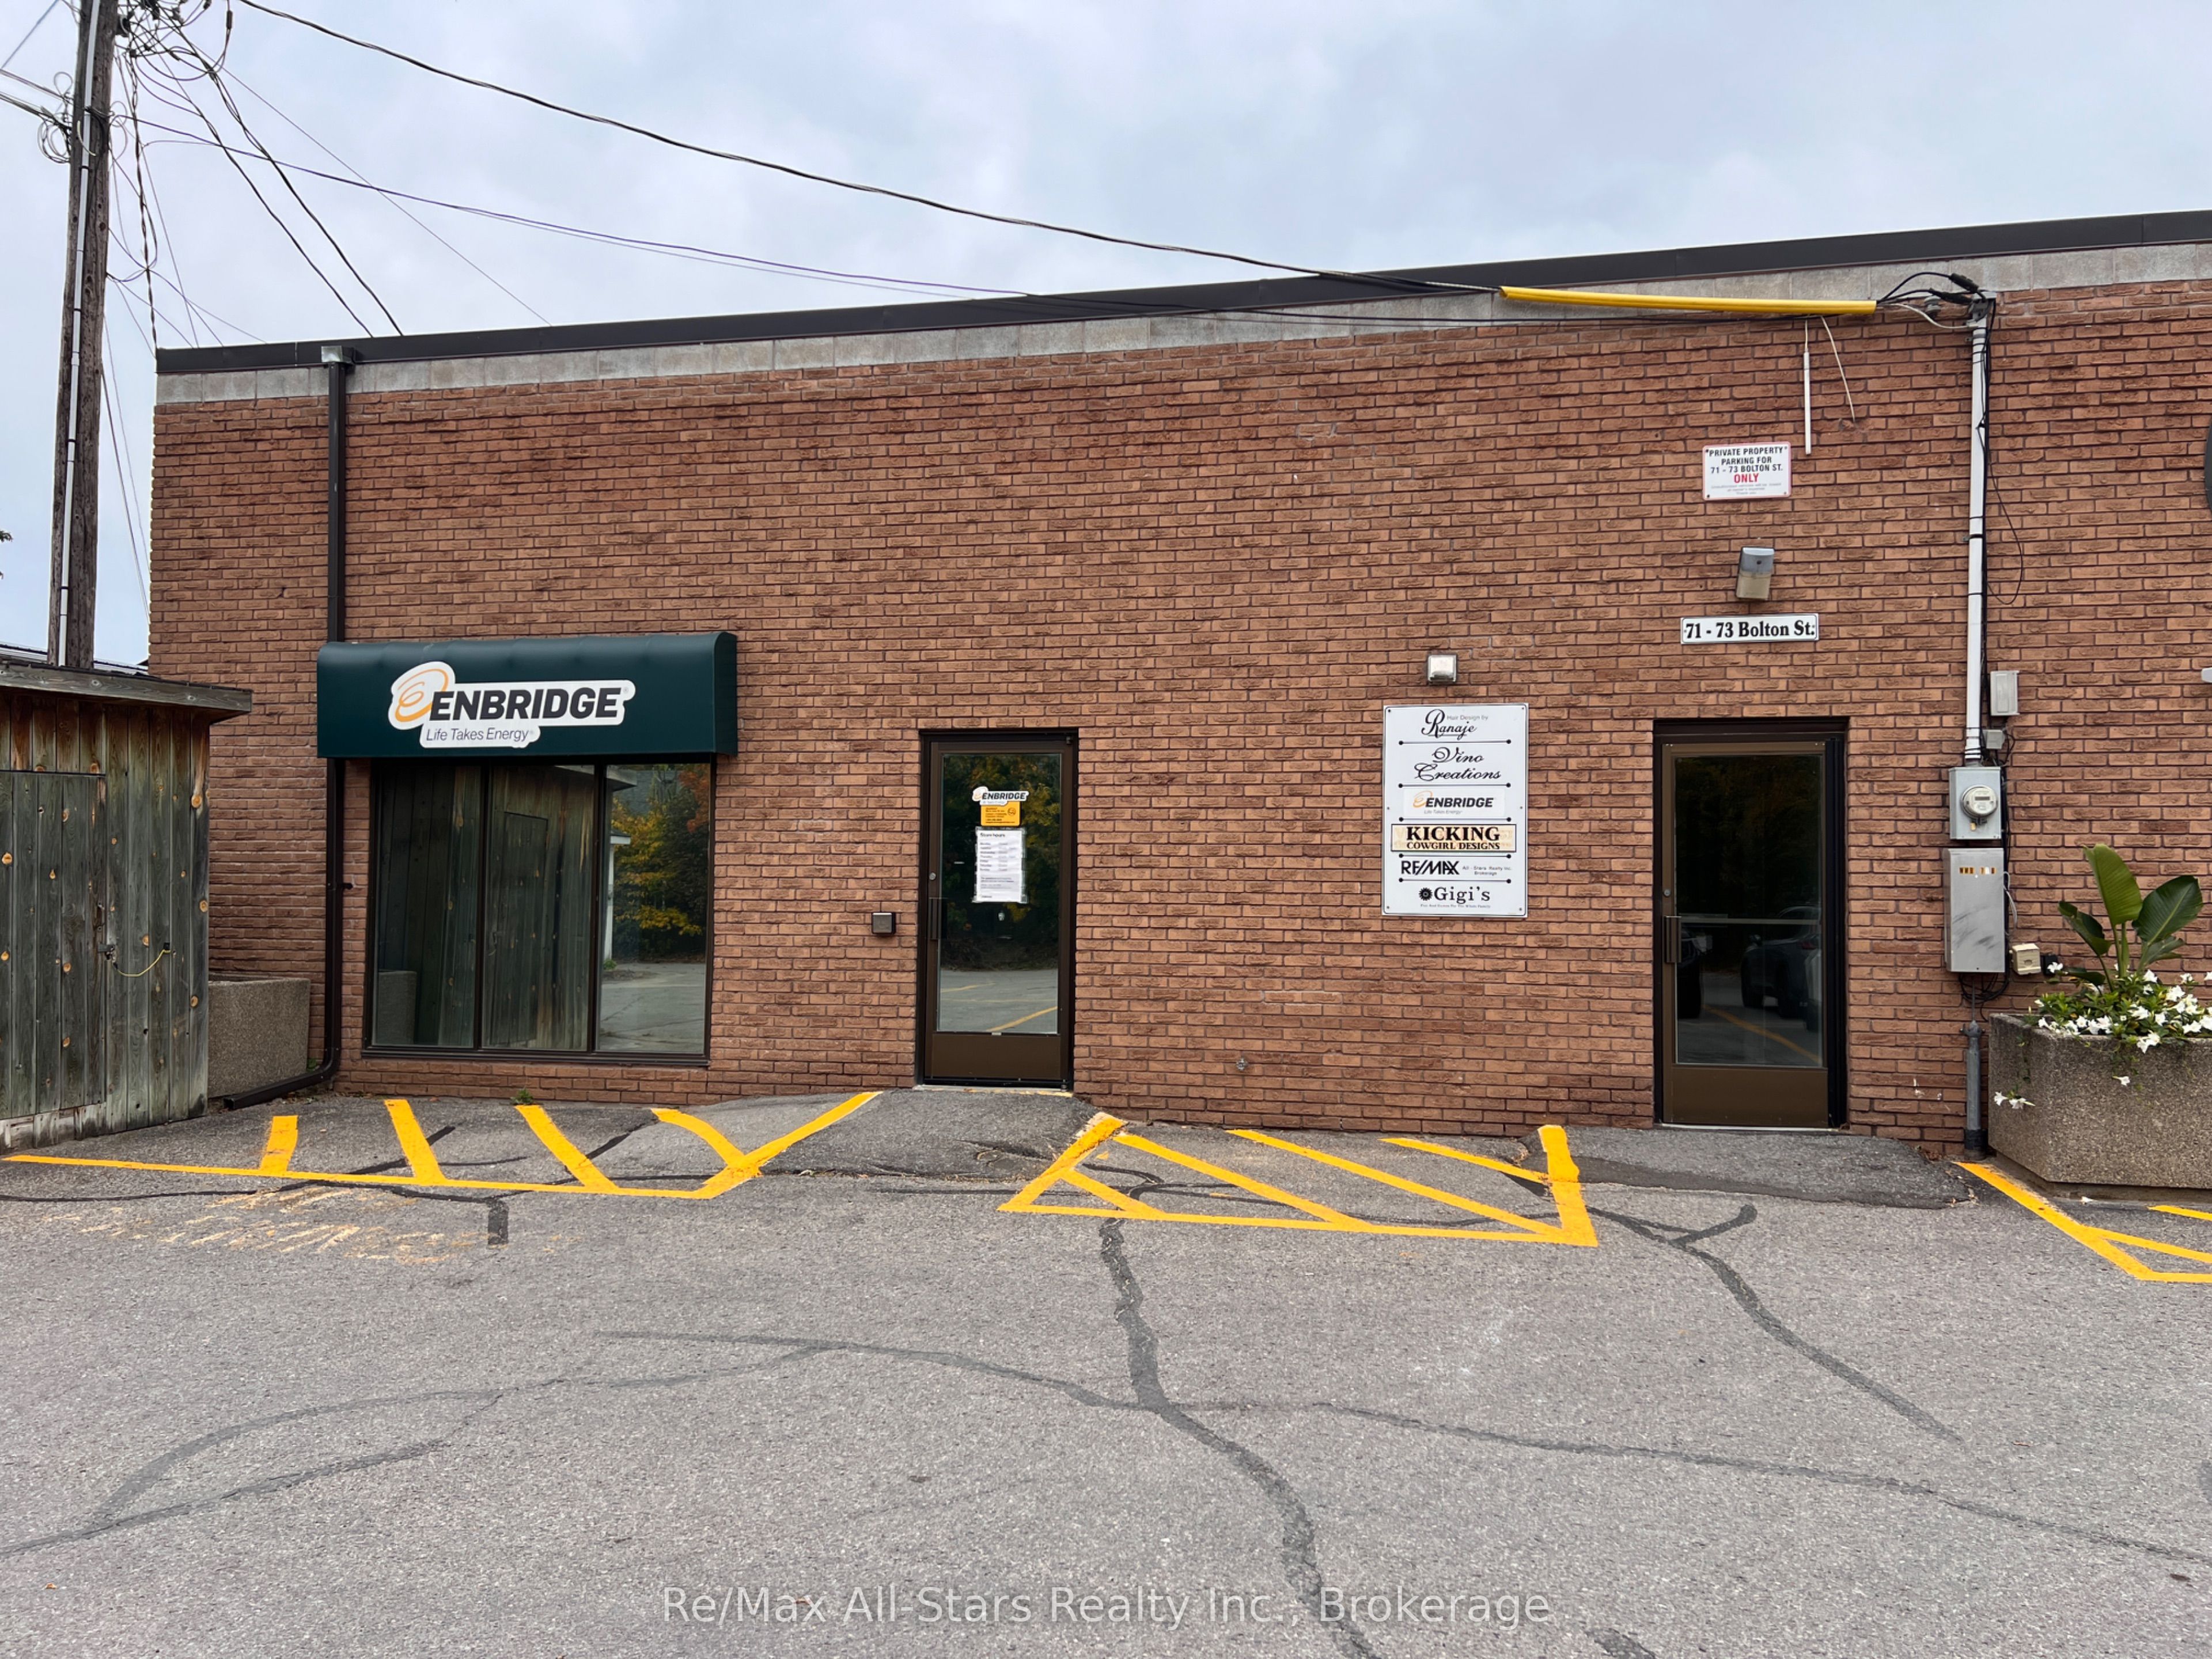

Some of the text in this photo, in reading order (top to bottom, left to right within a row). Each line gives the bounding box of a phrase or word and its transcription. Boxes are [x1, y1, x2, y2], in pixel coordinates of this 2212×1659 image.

[1709, 446, 1783, 457] PRIVATE PROPERTY
[1721, 457, 1754, 465] PARKING
[1741, 464, 1770, 472] BOLTON
[1734, 473, 1759, 483] ONLY
[1685, 623, 1702, 639] 71
[1715, 622, 1734, 638] 73
[1738, 621, 1790, 637] Bolton
[1794, 619, 1815, 636] St.
[429, 687, 622, 721] ENBRIDGE
[426, 727, 529, 742] Life Takes Energy
[1432, 747, 1484, 763] Vino
[1414, 762, 1501, 781] Creations
[1425, 797, 1494, 808] ENBRIDGE
[1406, 827, 1500, 841] KICKING
[1407, 842, 1500, 850] COWGIRL DESIGNS
[1401, 859, 1460, 876] RE/MAX
[1434, 886, 1491, 904] Gigi's
